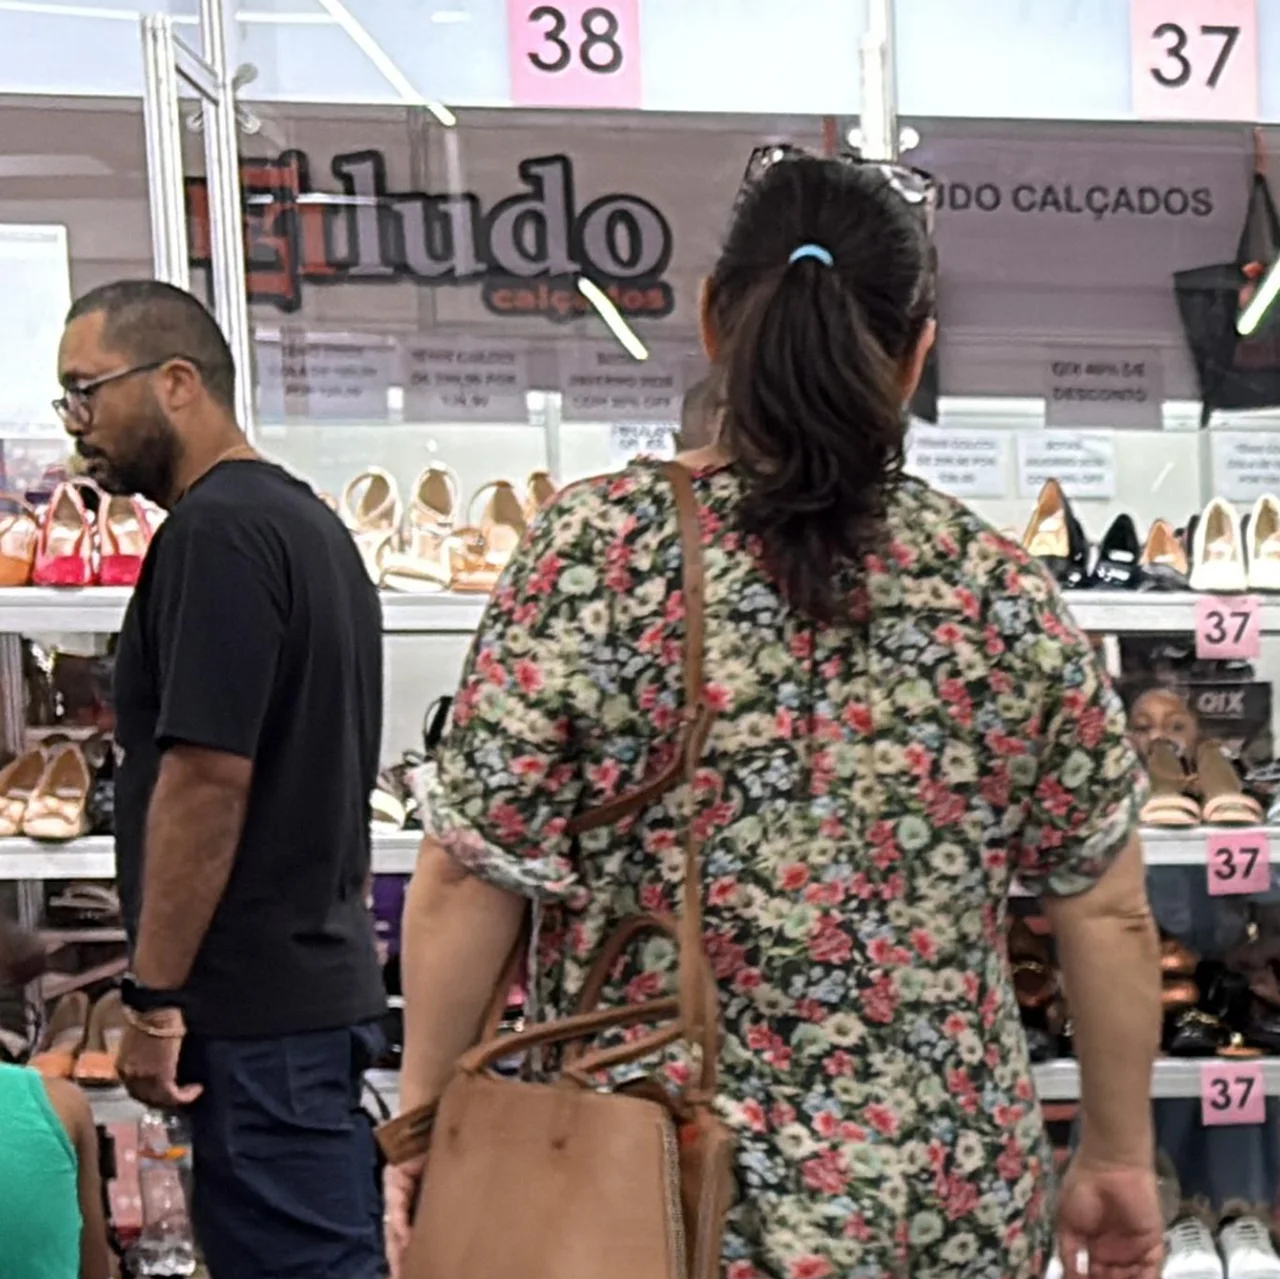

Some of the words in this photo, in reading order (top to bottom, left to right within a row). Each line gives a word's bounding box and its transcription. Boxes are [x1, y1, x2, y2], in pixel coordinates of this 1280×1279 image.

[528, 6, 623, 74] 38
[1150, 22, 1241, 88] 37
[936, 183, 1001, 212] DO
[1011, 183, 1215, 221] CALÇADOS
[1205, 611, 1251, 644] 37
[1214, 848, 1260, 881] 37
[1209, 1077, 1255, 1111] 37
